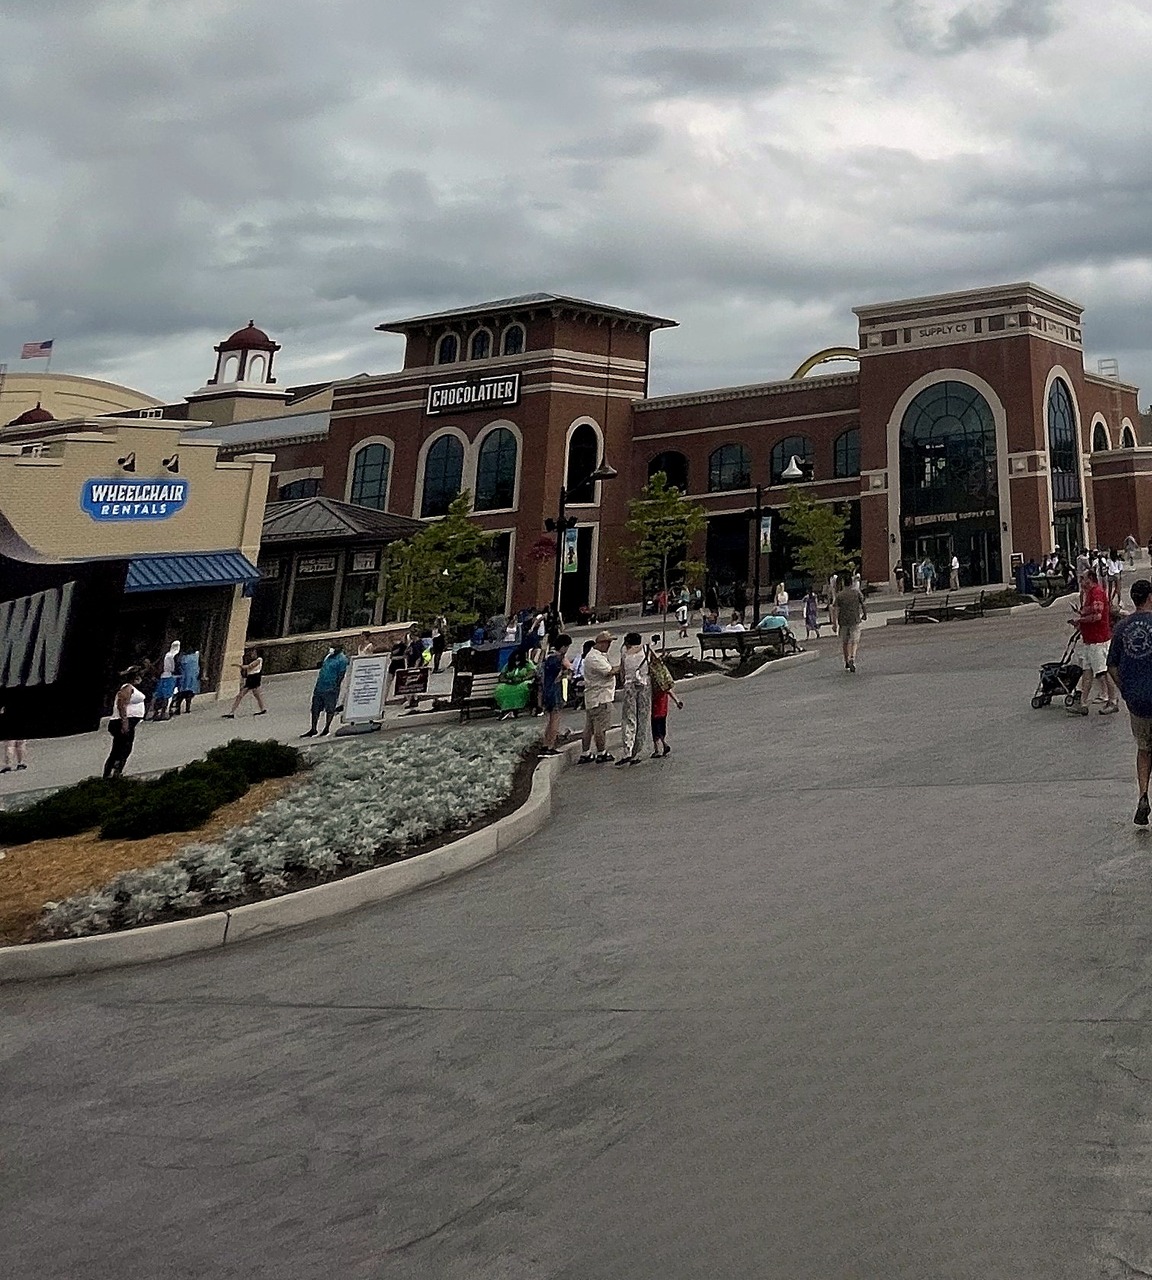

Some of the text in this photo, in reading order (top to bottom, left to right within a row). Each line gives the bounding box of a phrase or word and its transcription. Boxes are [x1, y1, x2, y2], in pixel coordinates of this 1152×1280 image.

[919, 326, 953, 338] SUPPLY
[432, 381, 513, 407] CHOCOLATIER
[91, 484, 184, 502] WHEELCHAIR
[100, 504, 167, 515] RENTALS
